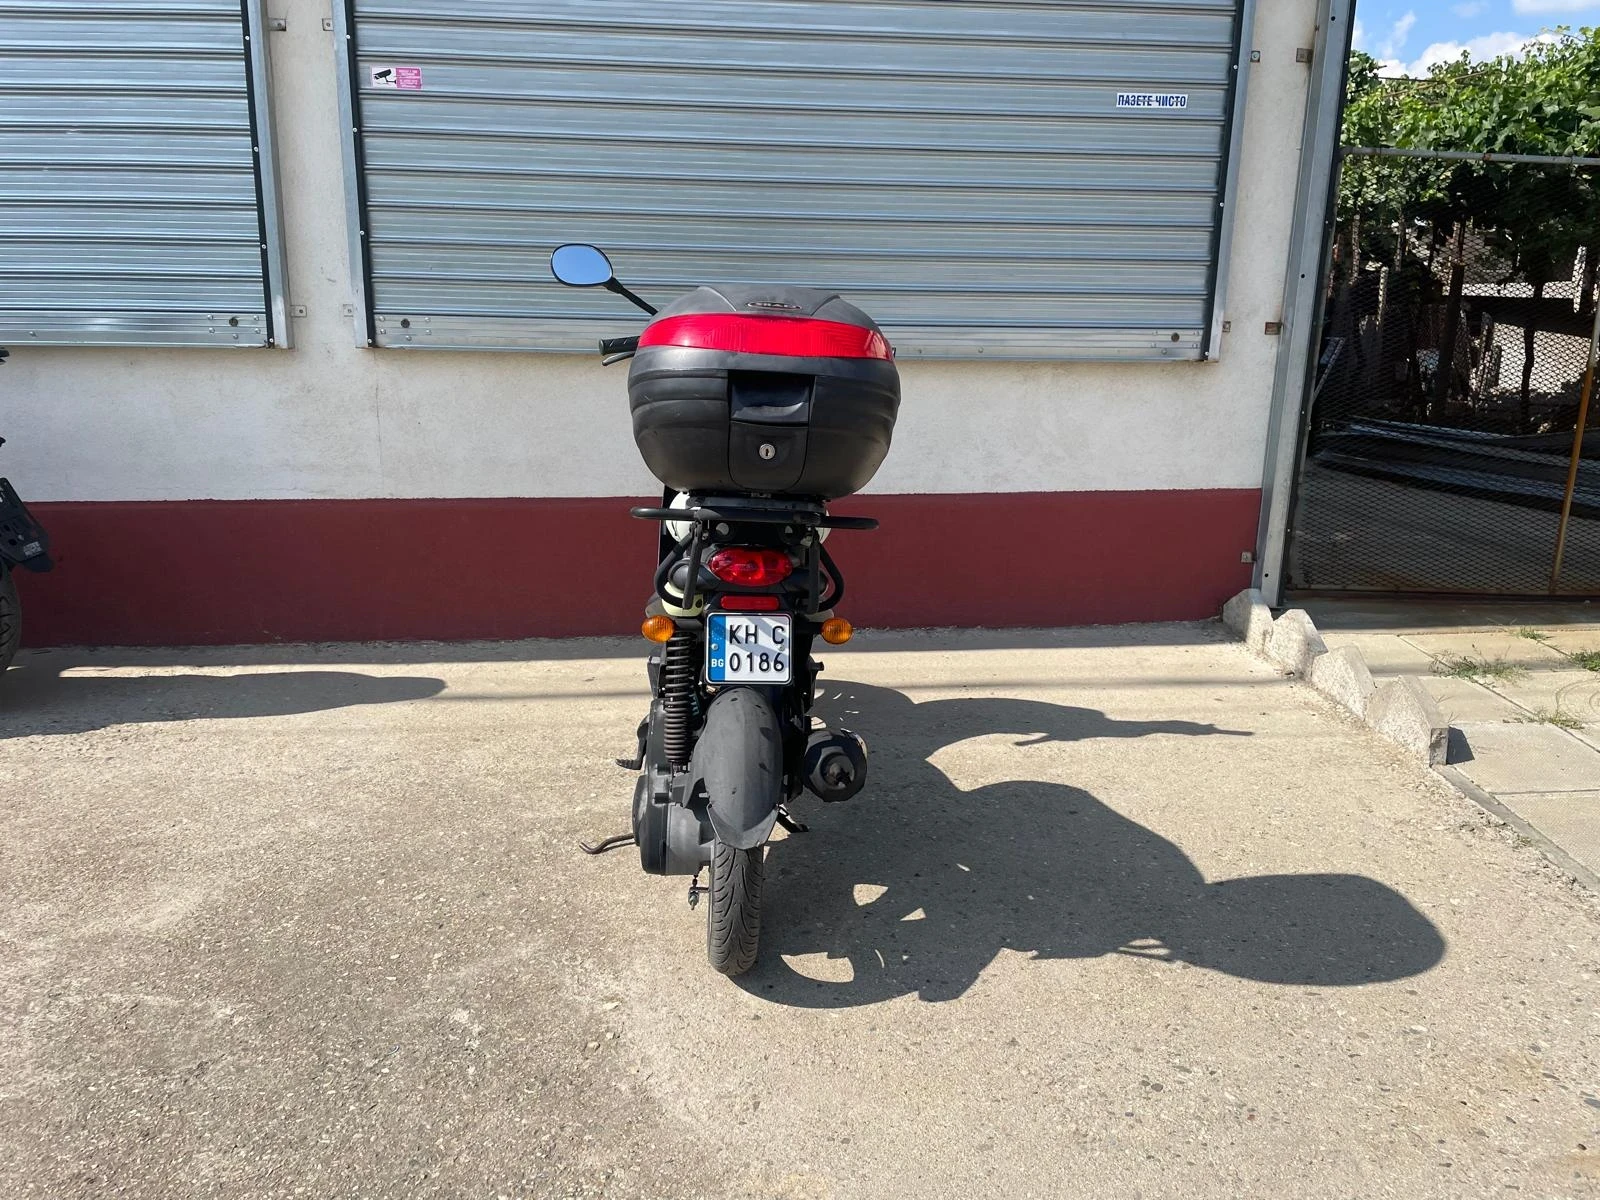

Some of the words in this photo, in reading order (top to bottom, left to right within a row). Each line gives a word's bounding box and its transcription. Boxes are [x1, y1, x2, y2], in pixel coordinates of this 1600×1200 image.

[1118, 95, 1153, 106] ПАЗЕТЕ
[1155, 95, 1186, 107] ЧИСТО
[729, 624, 758, 645] KH
[772, 625, 785, 645] C
[711, 658, 724, 668] BG
[729, 652, 785, 672] 0186
